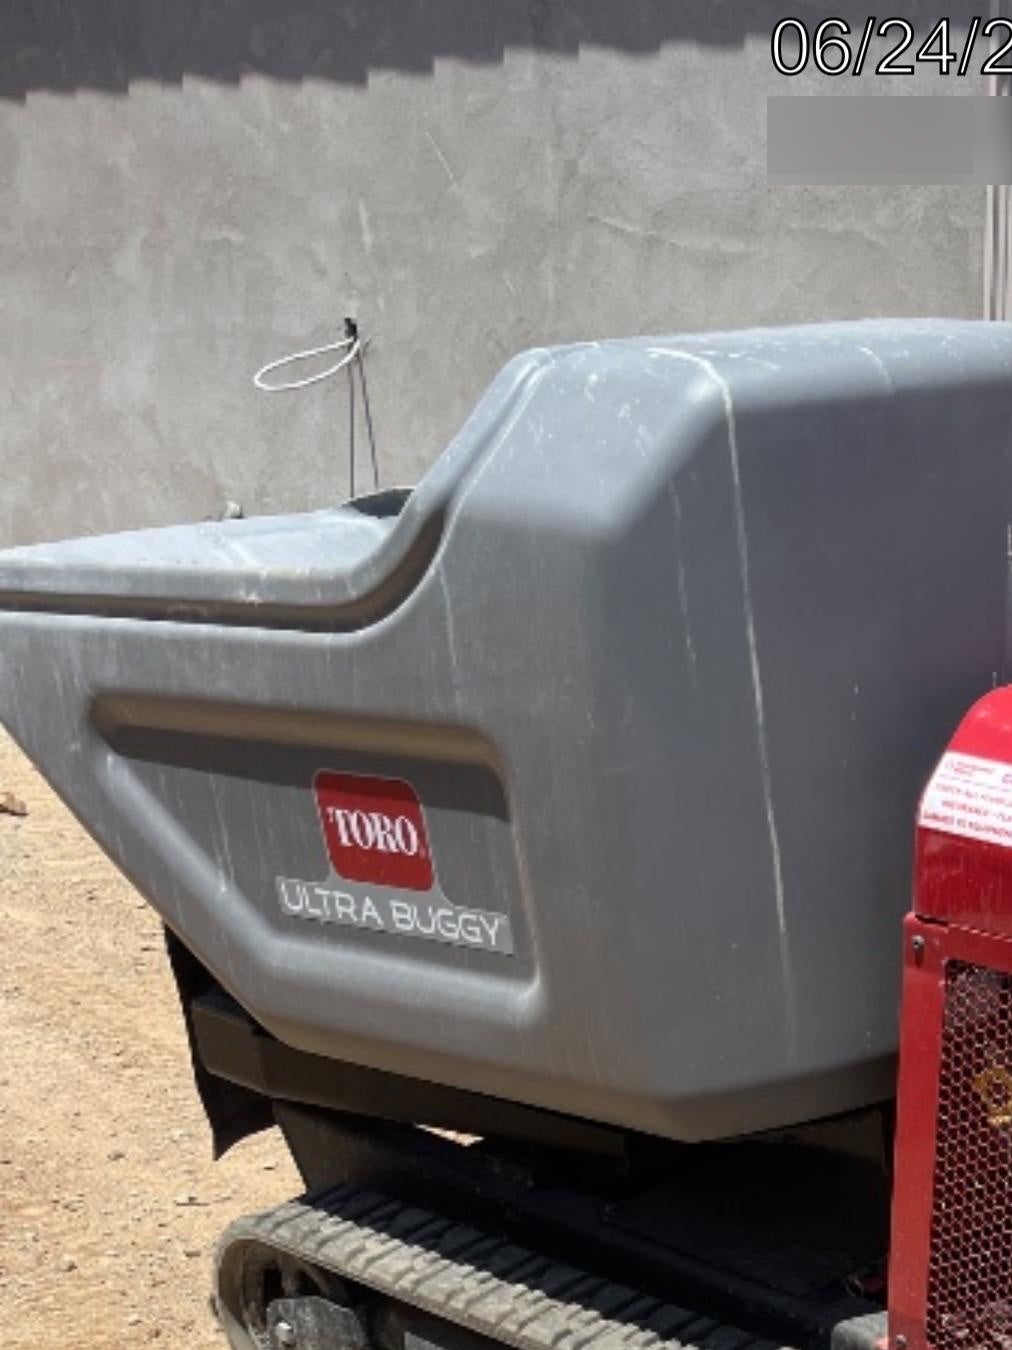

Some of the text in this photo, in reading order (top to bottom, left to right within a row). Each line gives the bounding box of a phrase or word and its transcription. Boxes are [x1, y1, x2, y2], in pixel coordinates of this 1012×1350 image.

[327, 807, 419, 856] TORO
[280, 881, 502, 946] ULTRA BUGGY
